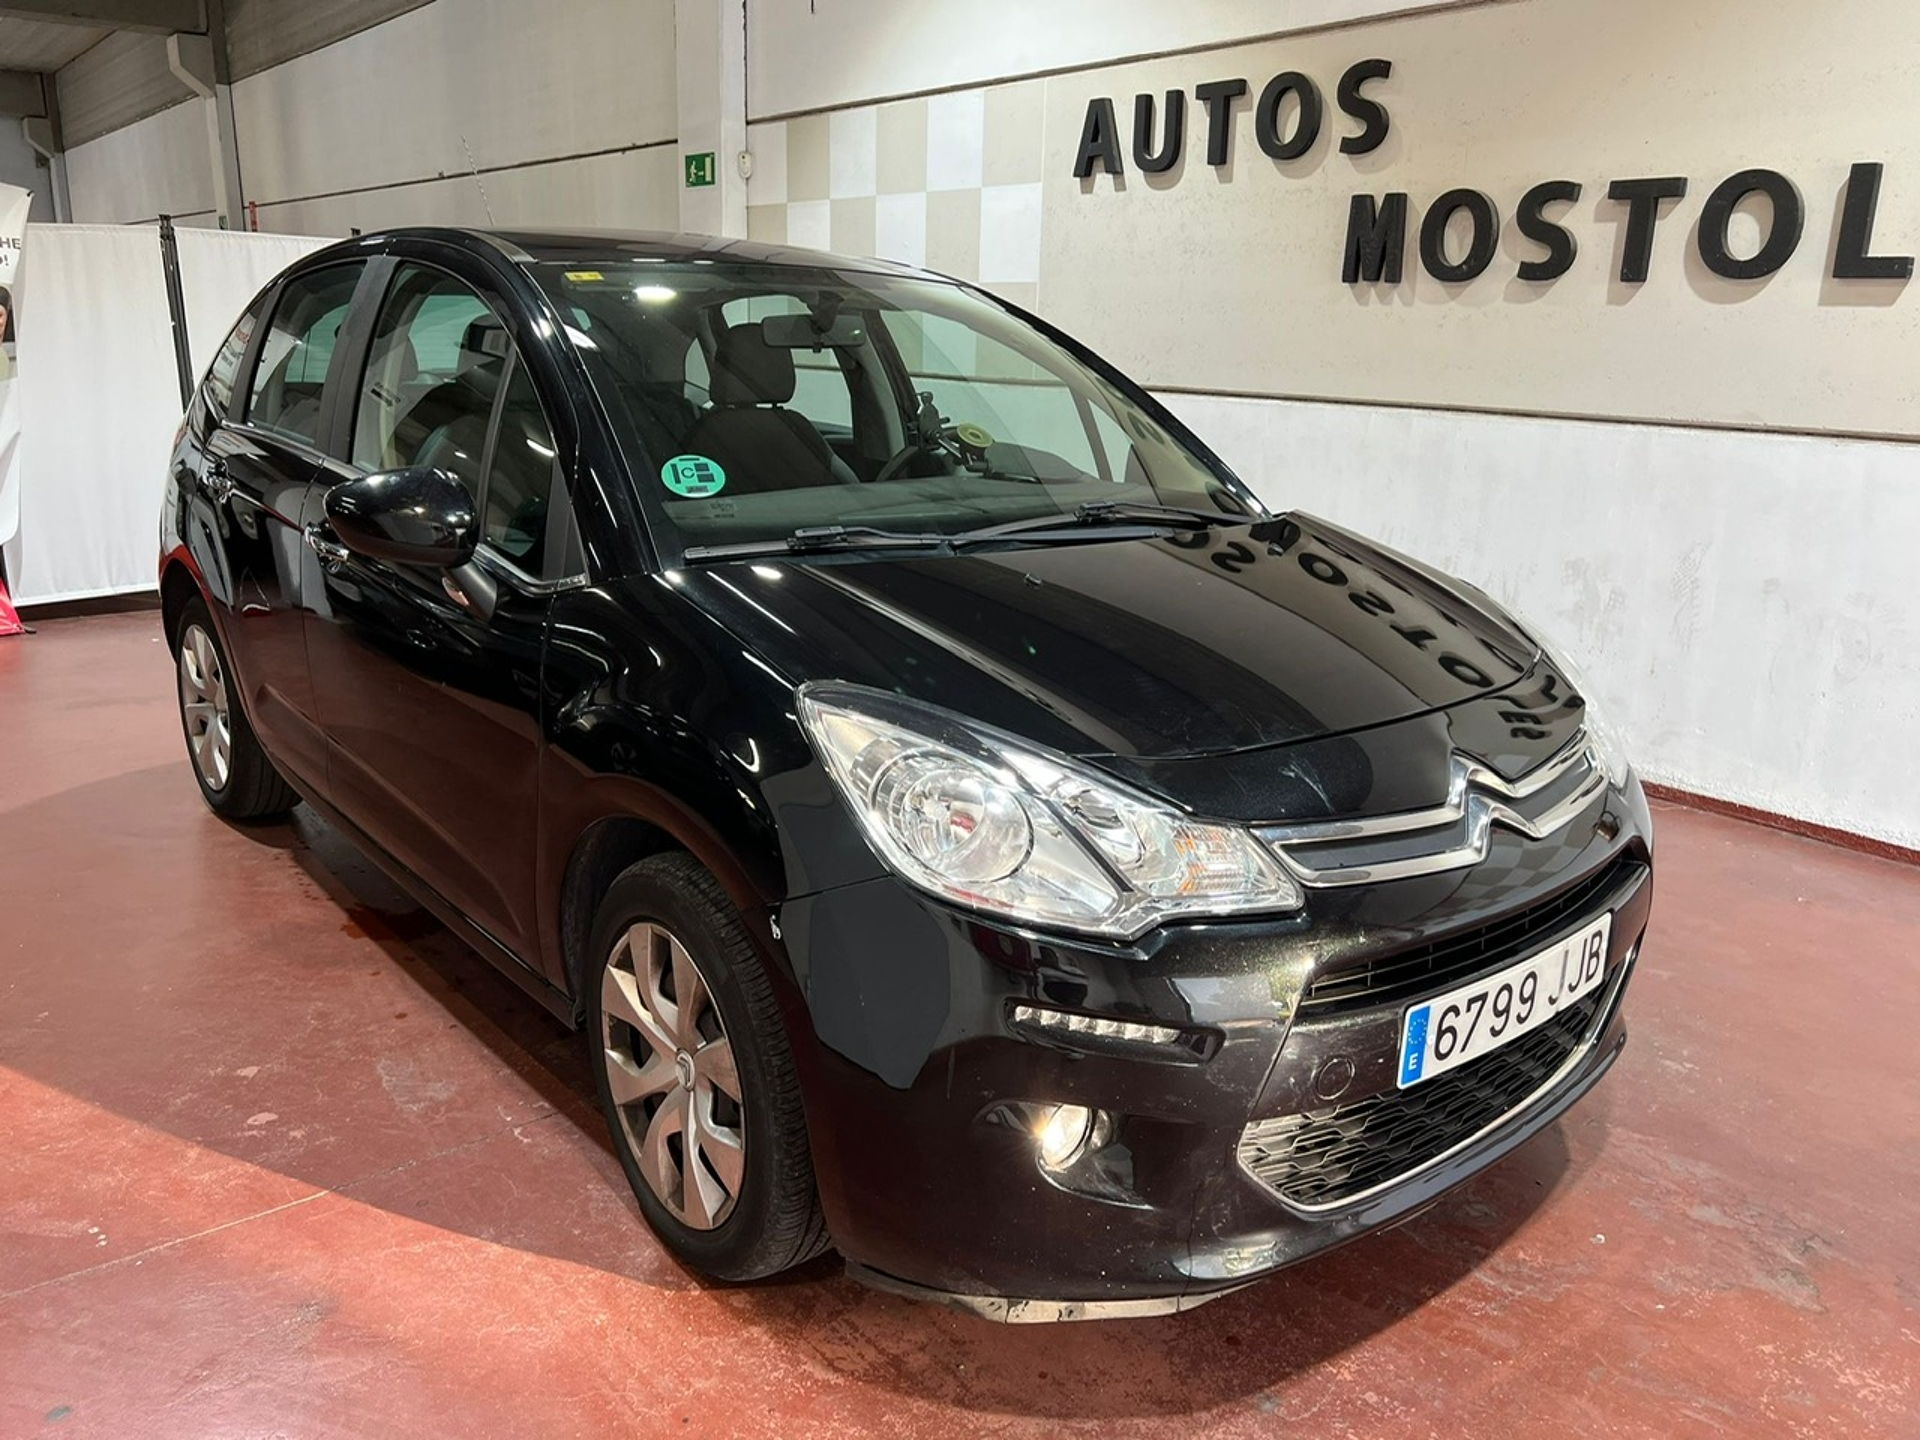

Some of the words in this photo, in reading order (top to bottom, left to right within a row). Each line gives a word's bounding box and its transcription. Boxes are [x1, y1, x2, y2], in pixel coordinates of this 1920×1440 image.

[1073, 58, 1392, 178] AUTOS
[1342, 161, 1916, 284] MOSTOL
[681, 467, 695, 479] C
[1433, 970, 1539, 1062] 6799
[1547, 929, 1603, 1006] JJB
[1408, 1053, 1419, 1071] E
